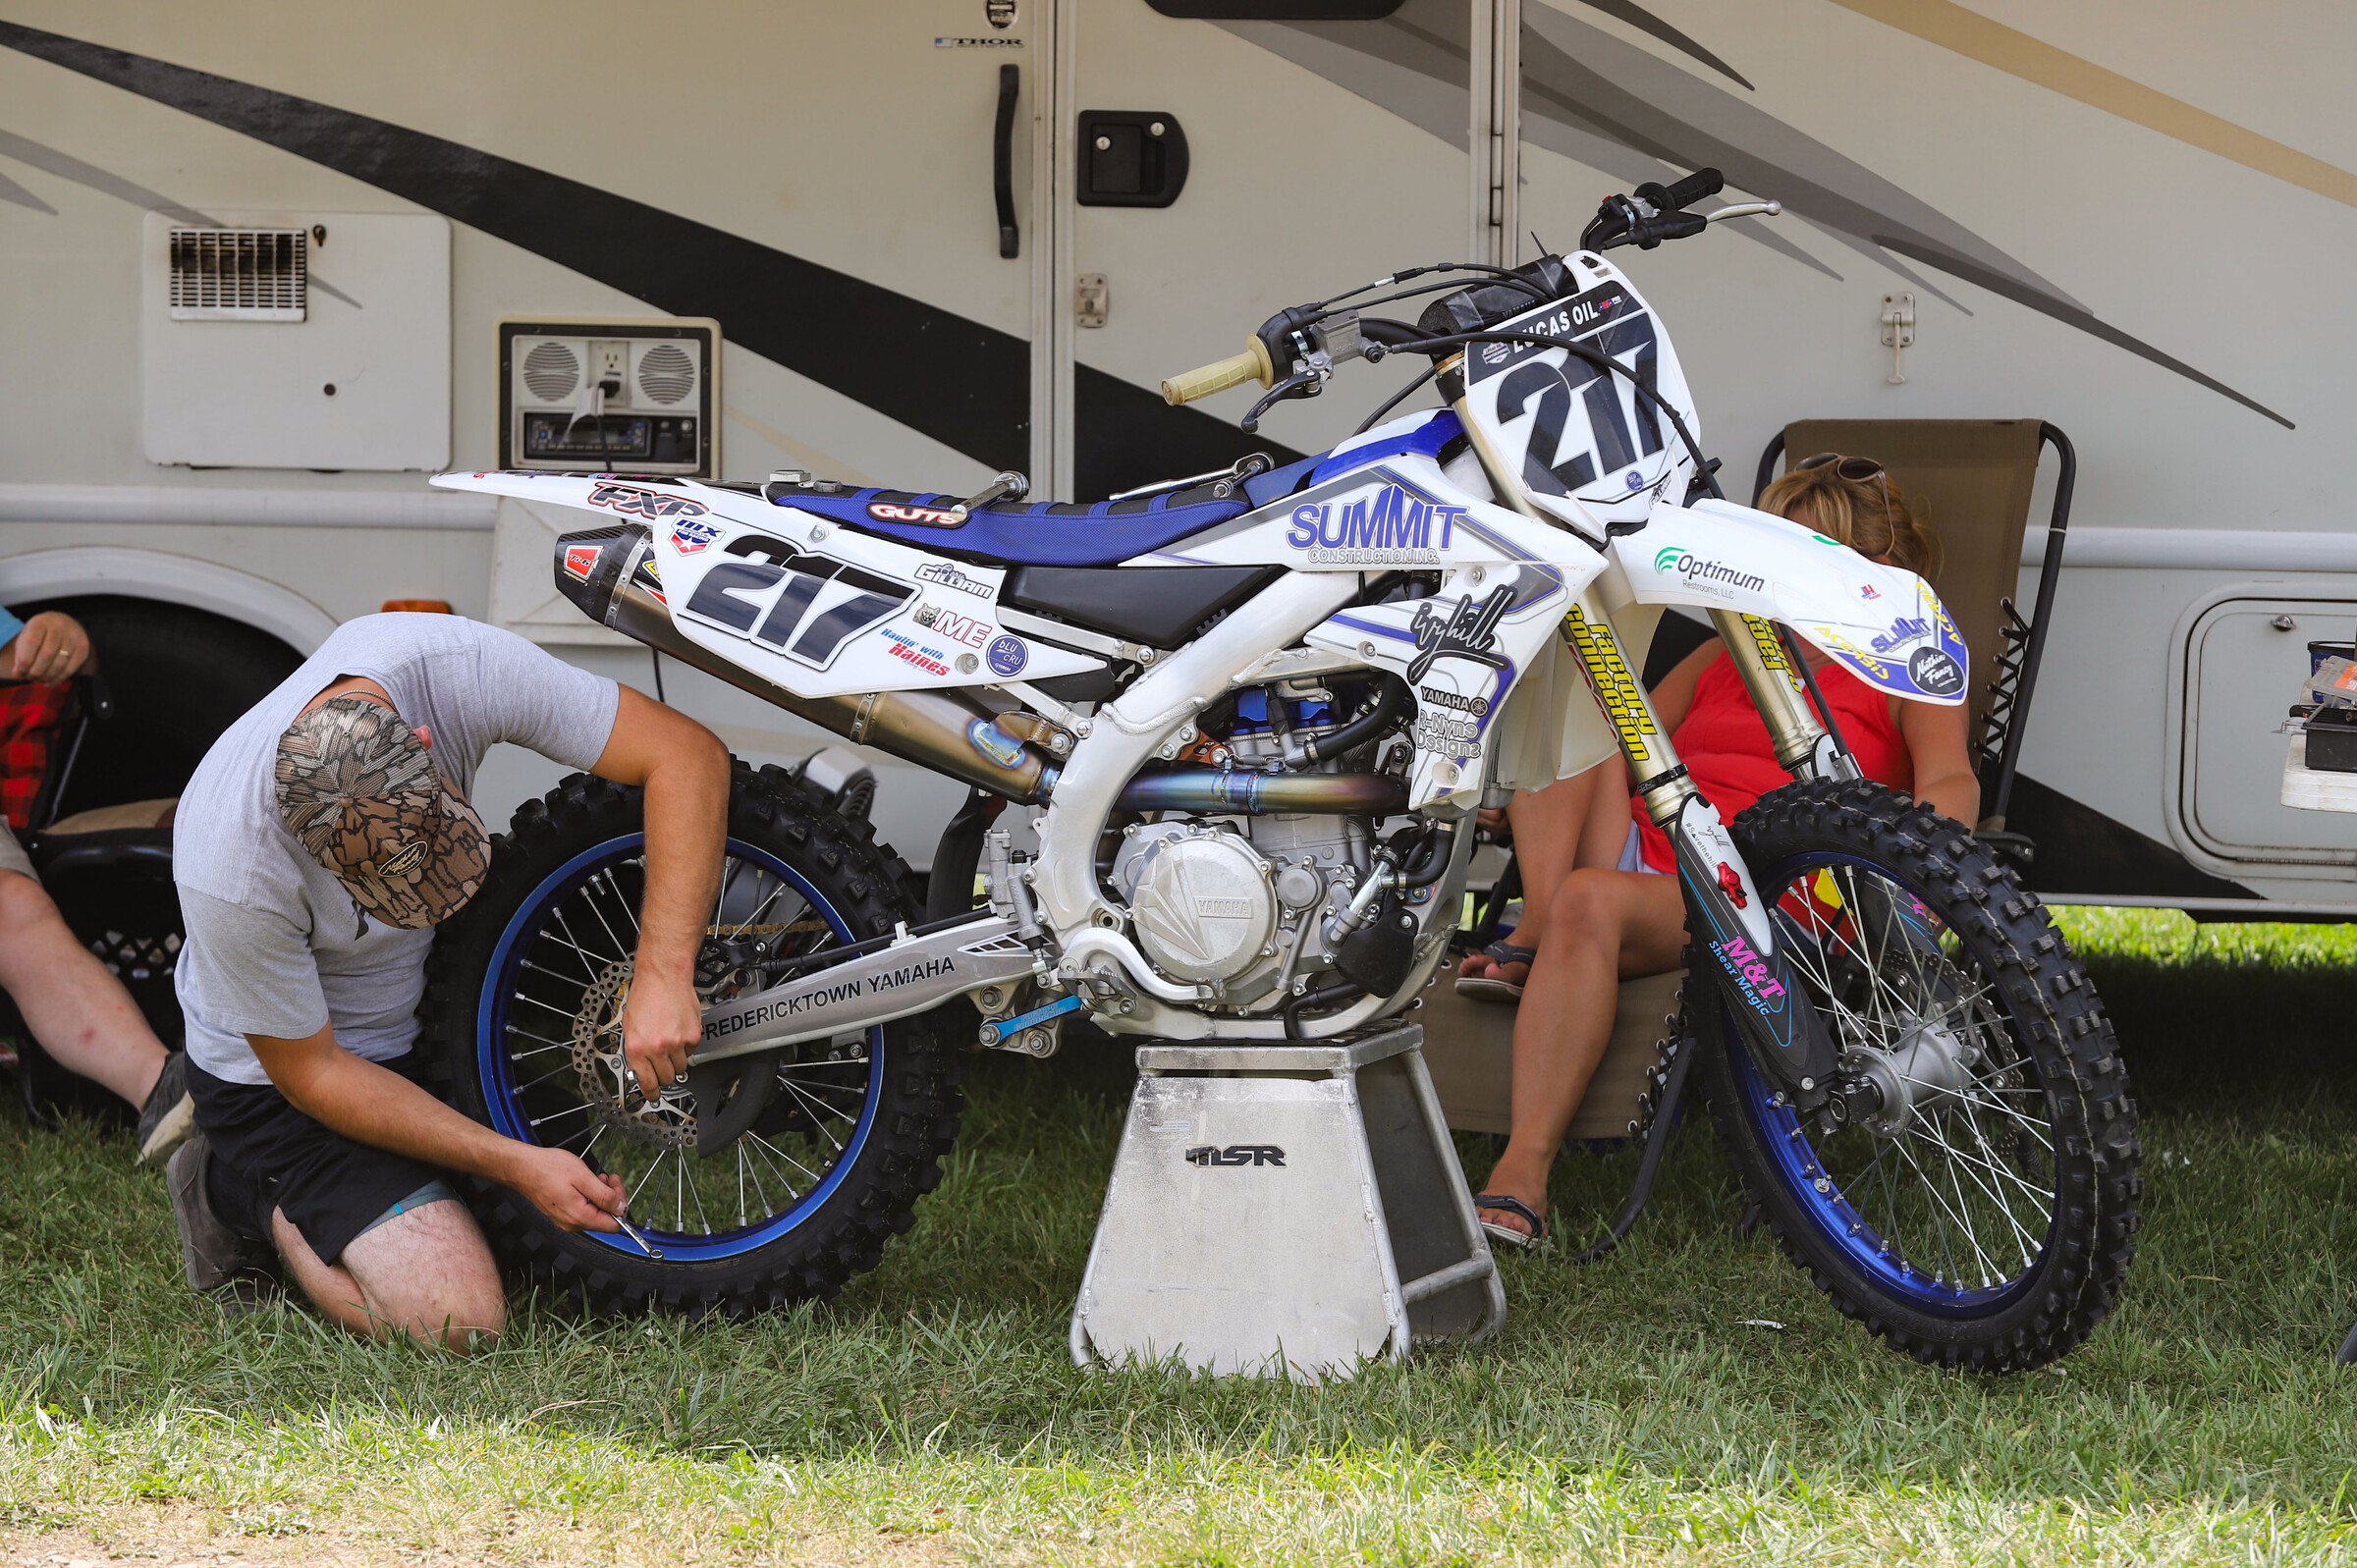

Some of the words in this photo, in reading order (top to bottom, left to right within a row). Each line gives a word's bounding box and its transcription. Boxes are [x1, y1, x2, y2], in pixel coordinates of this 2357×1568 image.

[1572, 300, 1600, 326] OIL
[1496, 311, 1666, 496] 217
[869, 504, 961, 525] GUTS
[1287, 484, 1469, 550] SUMMIT
[1308, 548, 1410, 565] CONSTRUCTION
[1677, 554, 1765, 592] Optimum
[685, 534, 919, 670] 217
[1682, 578, 1721, 597] Restrooms,
[1721, 589, 1735, 600] LLC
[933, 611, 993, 649] ME
[1739, 613, 1785, 670] Fact
[888, 642, 951, 676] Haines
[920, 646, 944, 660] with
[1565, 603, 1650, 761] connection
[1588, 623, 1658, 734] Factory
[1420, 685, 1471, 712] YAMAHA
[1417, 730, 1481, 760] Designs
[1198, 899, 1250, 916] YAMAHA
[1708, 940, 1737, 976] Shear
[1734, 975, 1771, 1016] Magic
[1722, 936, 1786, 1000] M&T
[700, 980, 861, 1041] REDERICKTOWN
[867, 955, 956, 994] YAMAHA
